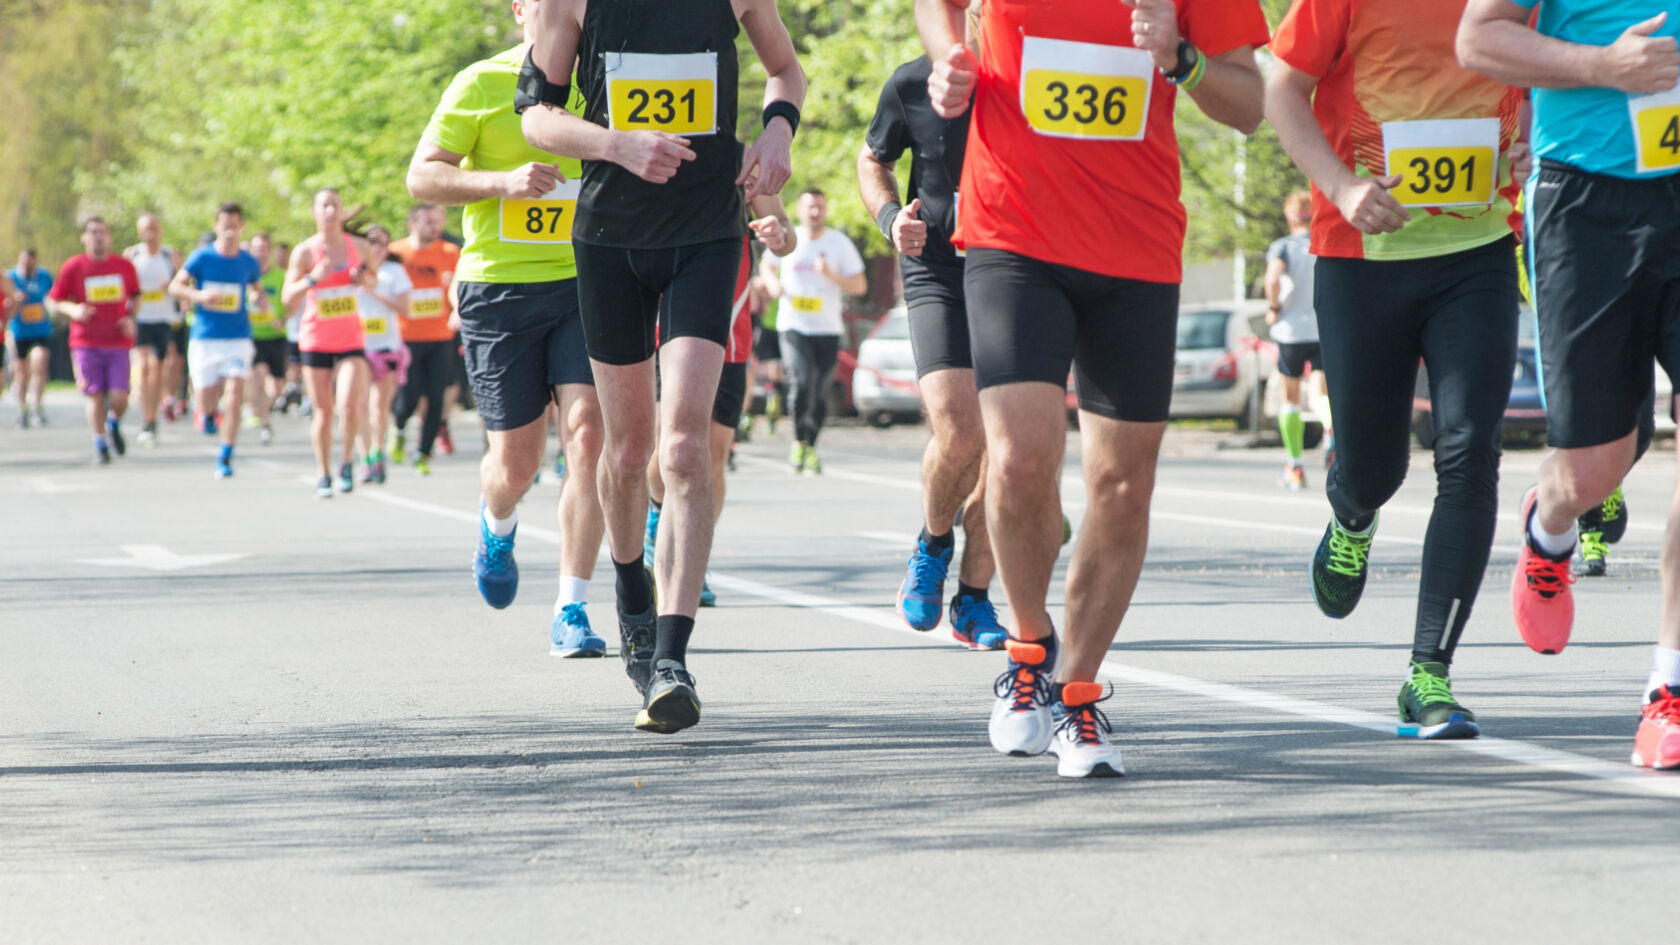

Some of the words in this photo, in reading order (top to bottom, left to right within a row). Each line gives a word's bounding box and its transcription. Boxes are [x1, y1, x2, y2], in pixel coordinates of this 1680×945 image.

[628, 88, 695, 124] 231
[1044, 82, 1128, 125] 336
[1660, 115, 1680, 155] 4
[1410, 155, 1475, 194] 391
[527, 206, 563, 234] 87
